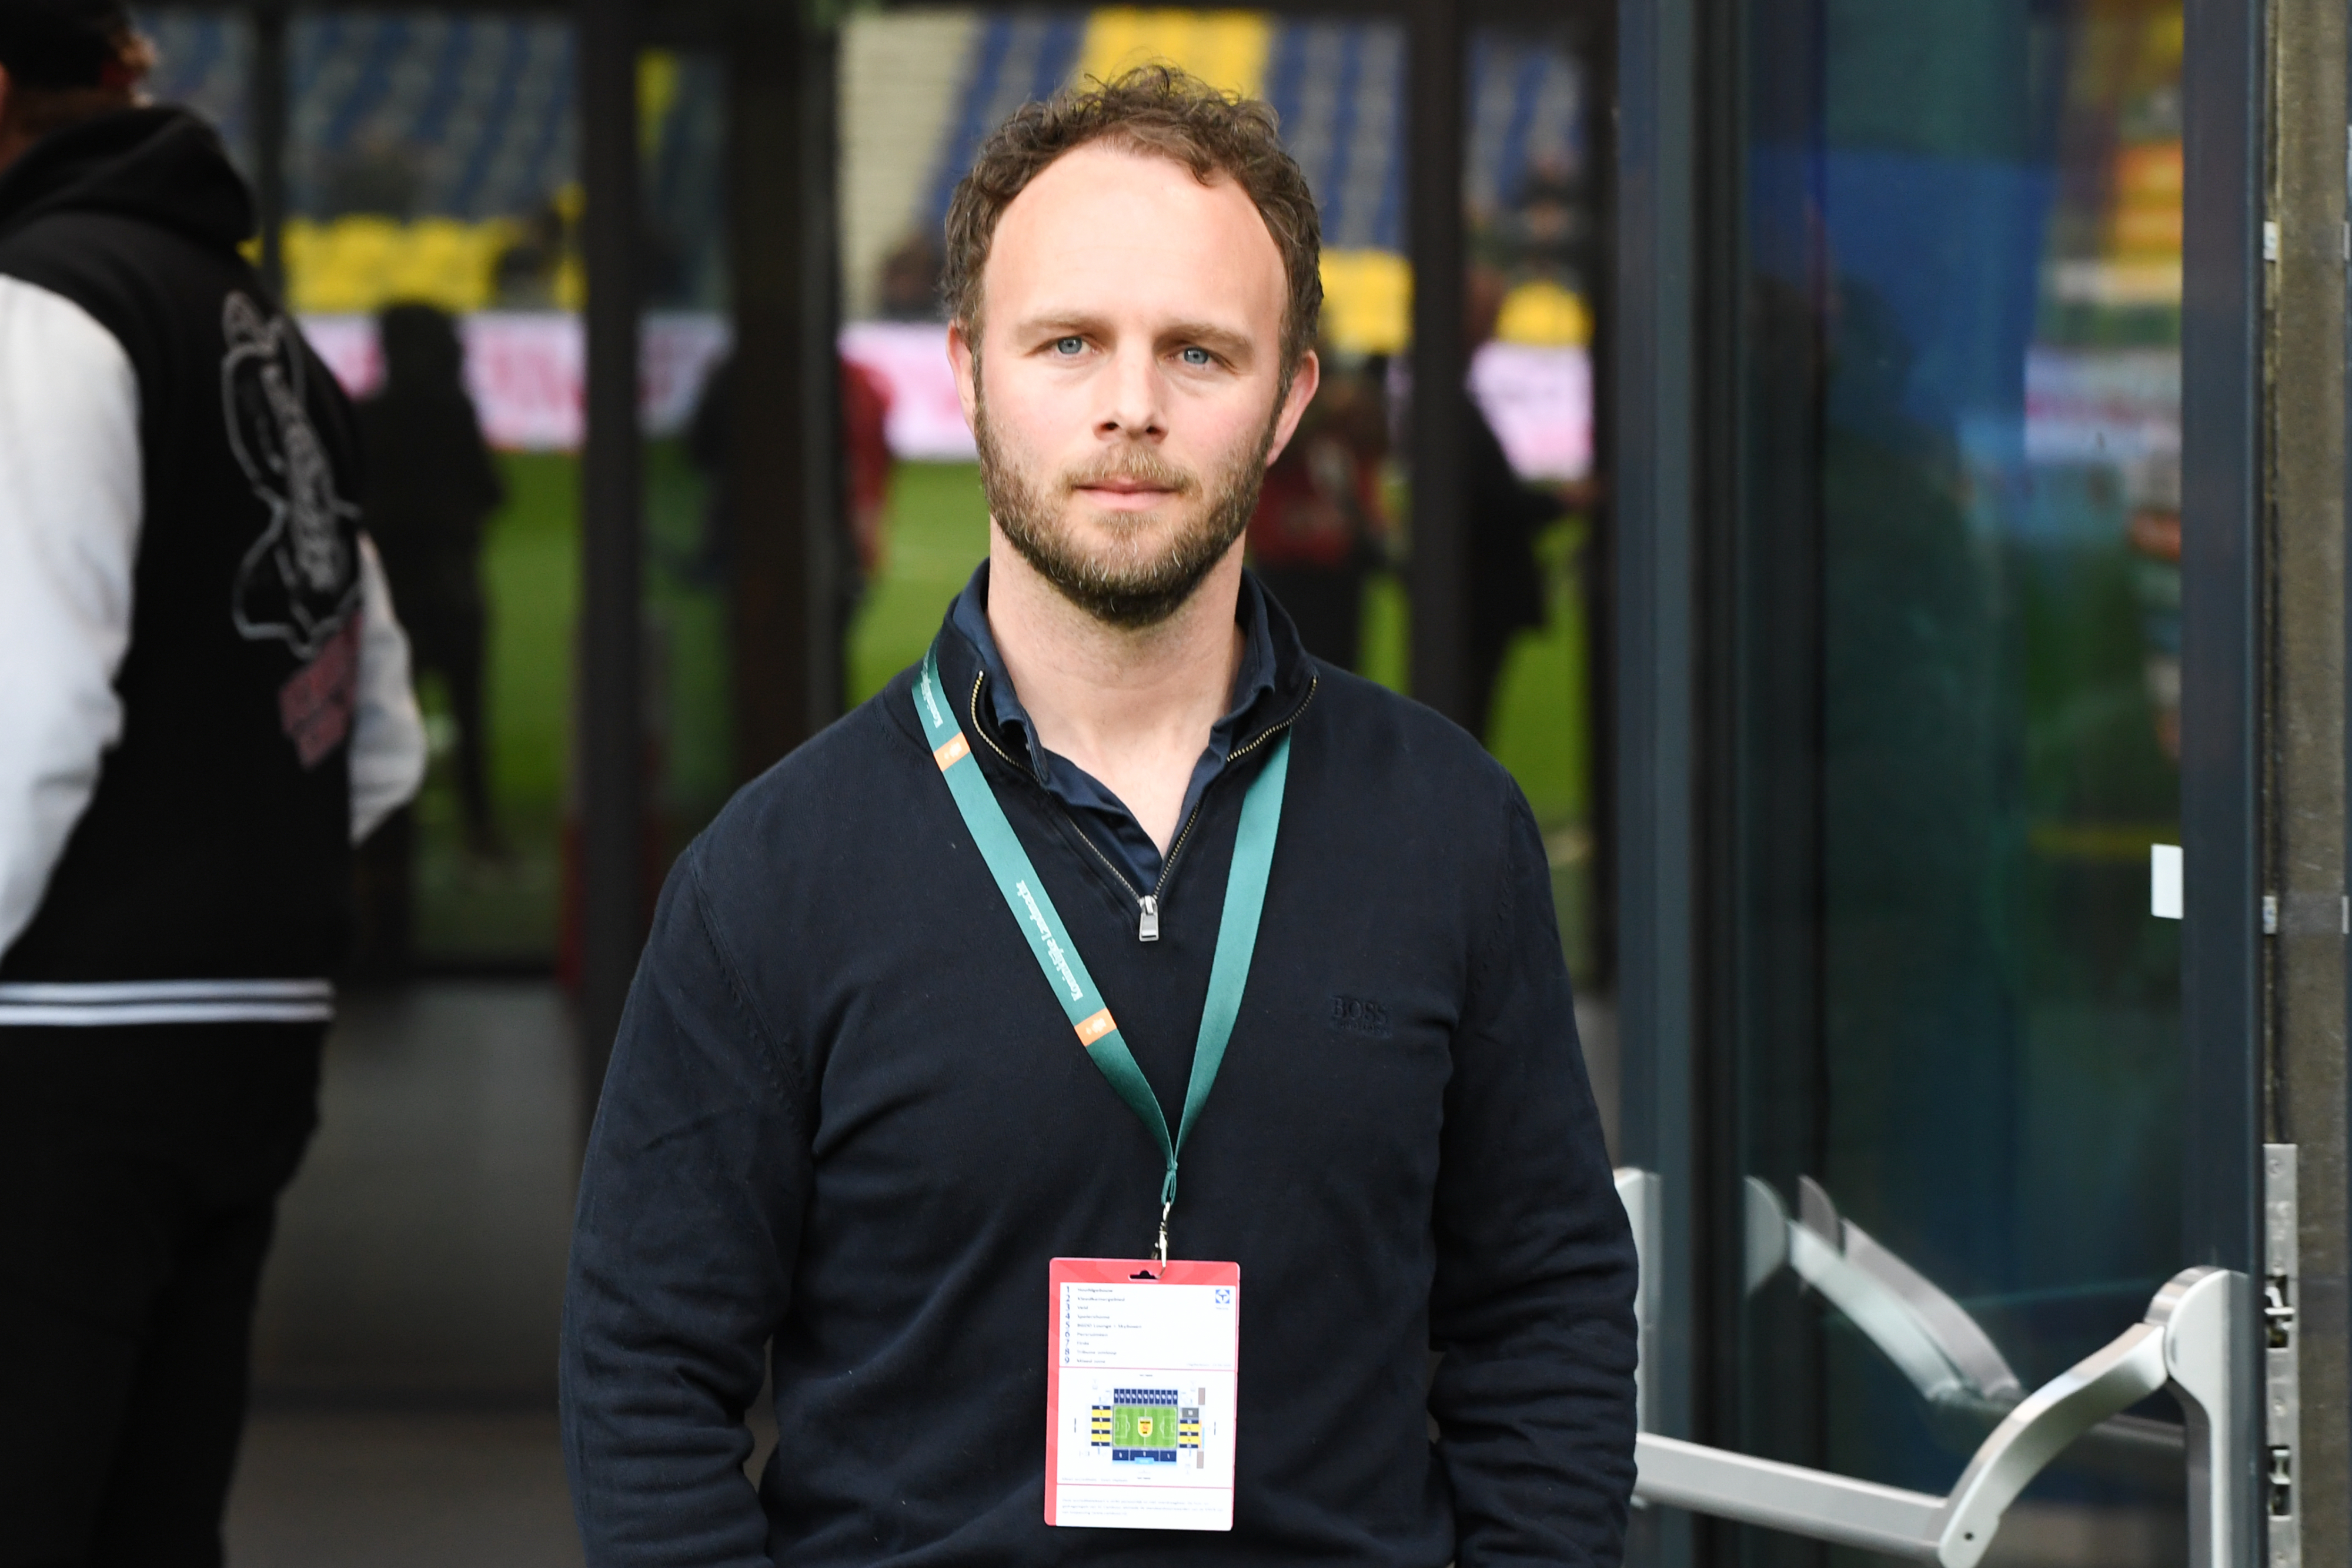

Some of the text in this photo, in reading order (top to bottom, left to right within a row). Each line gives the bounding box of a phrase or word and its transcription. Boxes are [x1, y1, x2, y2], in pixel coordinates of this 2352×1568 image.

[1331, 995, 1388, 1025] BOSS
[1066, 1285, 1070, 1293] 1
[1065, 1294, 1070, 1302] 2
[1065, 1339, 1070, 1347] 7
